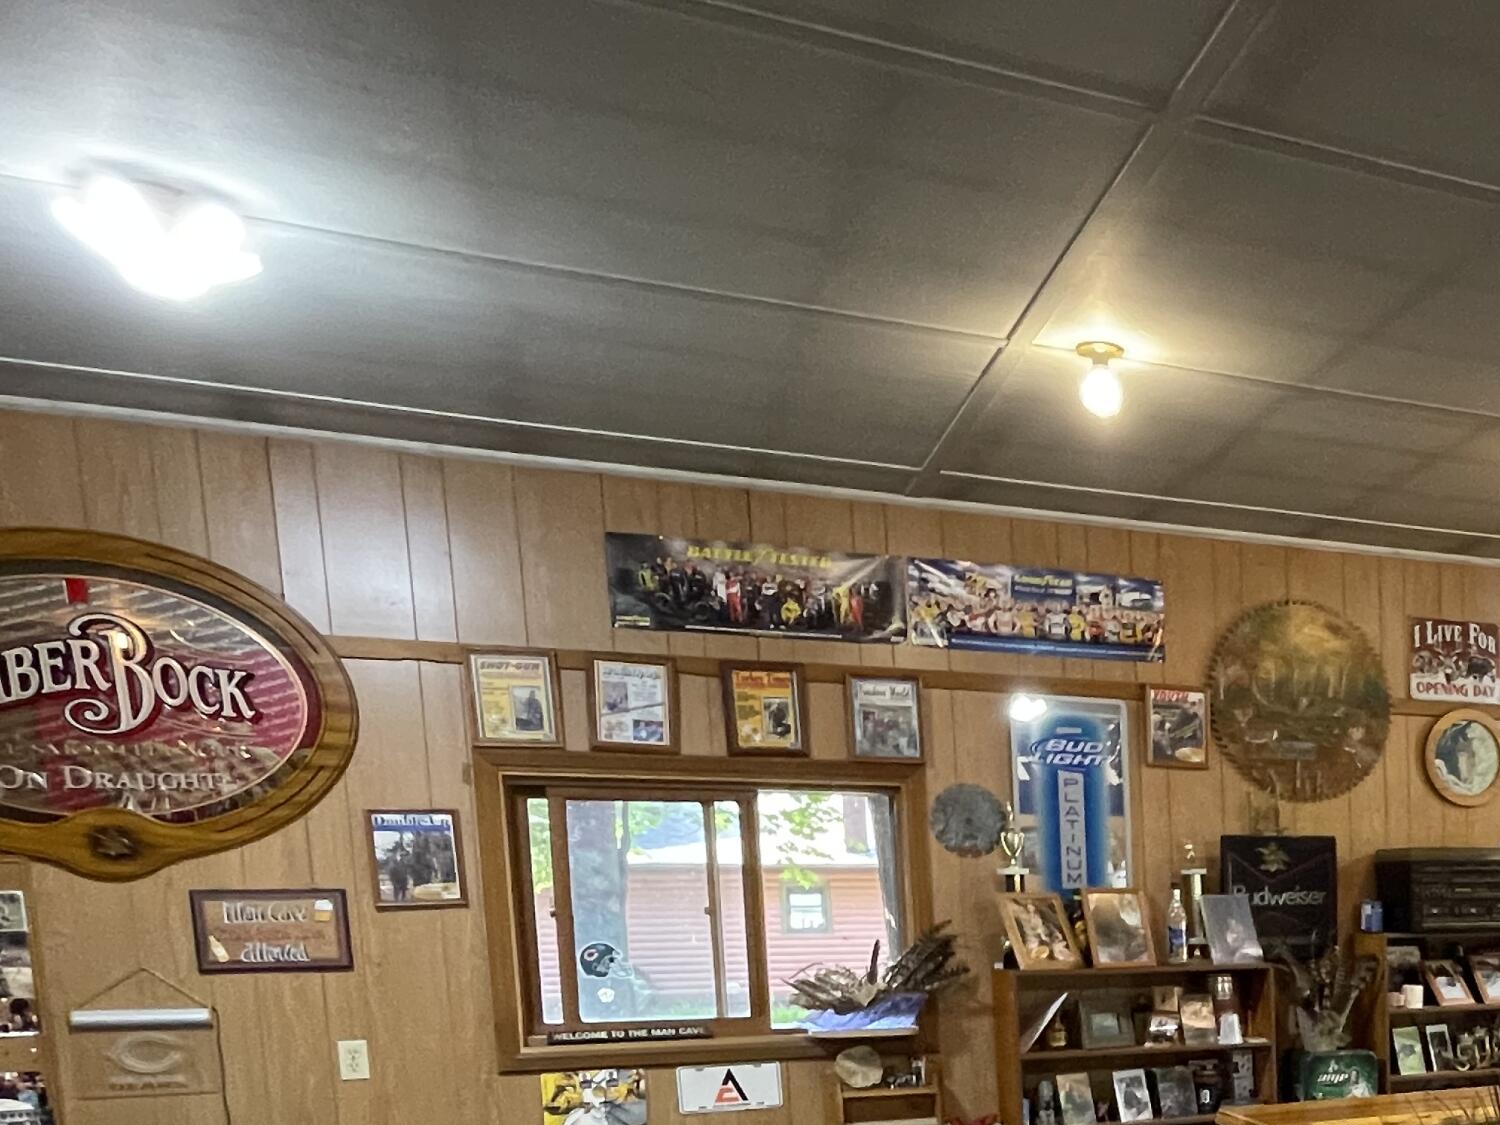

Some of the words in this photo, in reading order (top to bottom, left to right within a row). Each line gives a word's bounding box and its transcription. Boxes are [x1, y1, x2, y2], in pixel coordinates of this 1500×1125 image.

[1413, 624, 1421, 648] I
[1425, 620, 1463, 645] LIVE
[1466, 622, 1497, 655] FOR
[1416, 681, 1469, 698] OPENING
[1473, 684, 1497, 698] DAY
[1045, 738, 1104, 753] BUD
[1062, 777, 1084, 884] PLATINUM
[552, 1031, 608, 1041] WELCOME
[611, 1030, 625, 1039] TO
[628, 1029, 650, 1038] THE
[651, 1028, 676, 1037] MAN
[678, 1026, 707, 1036] CAVE
